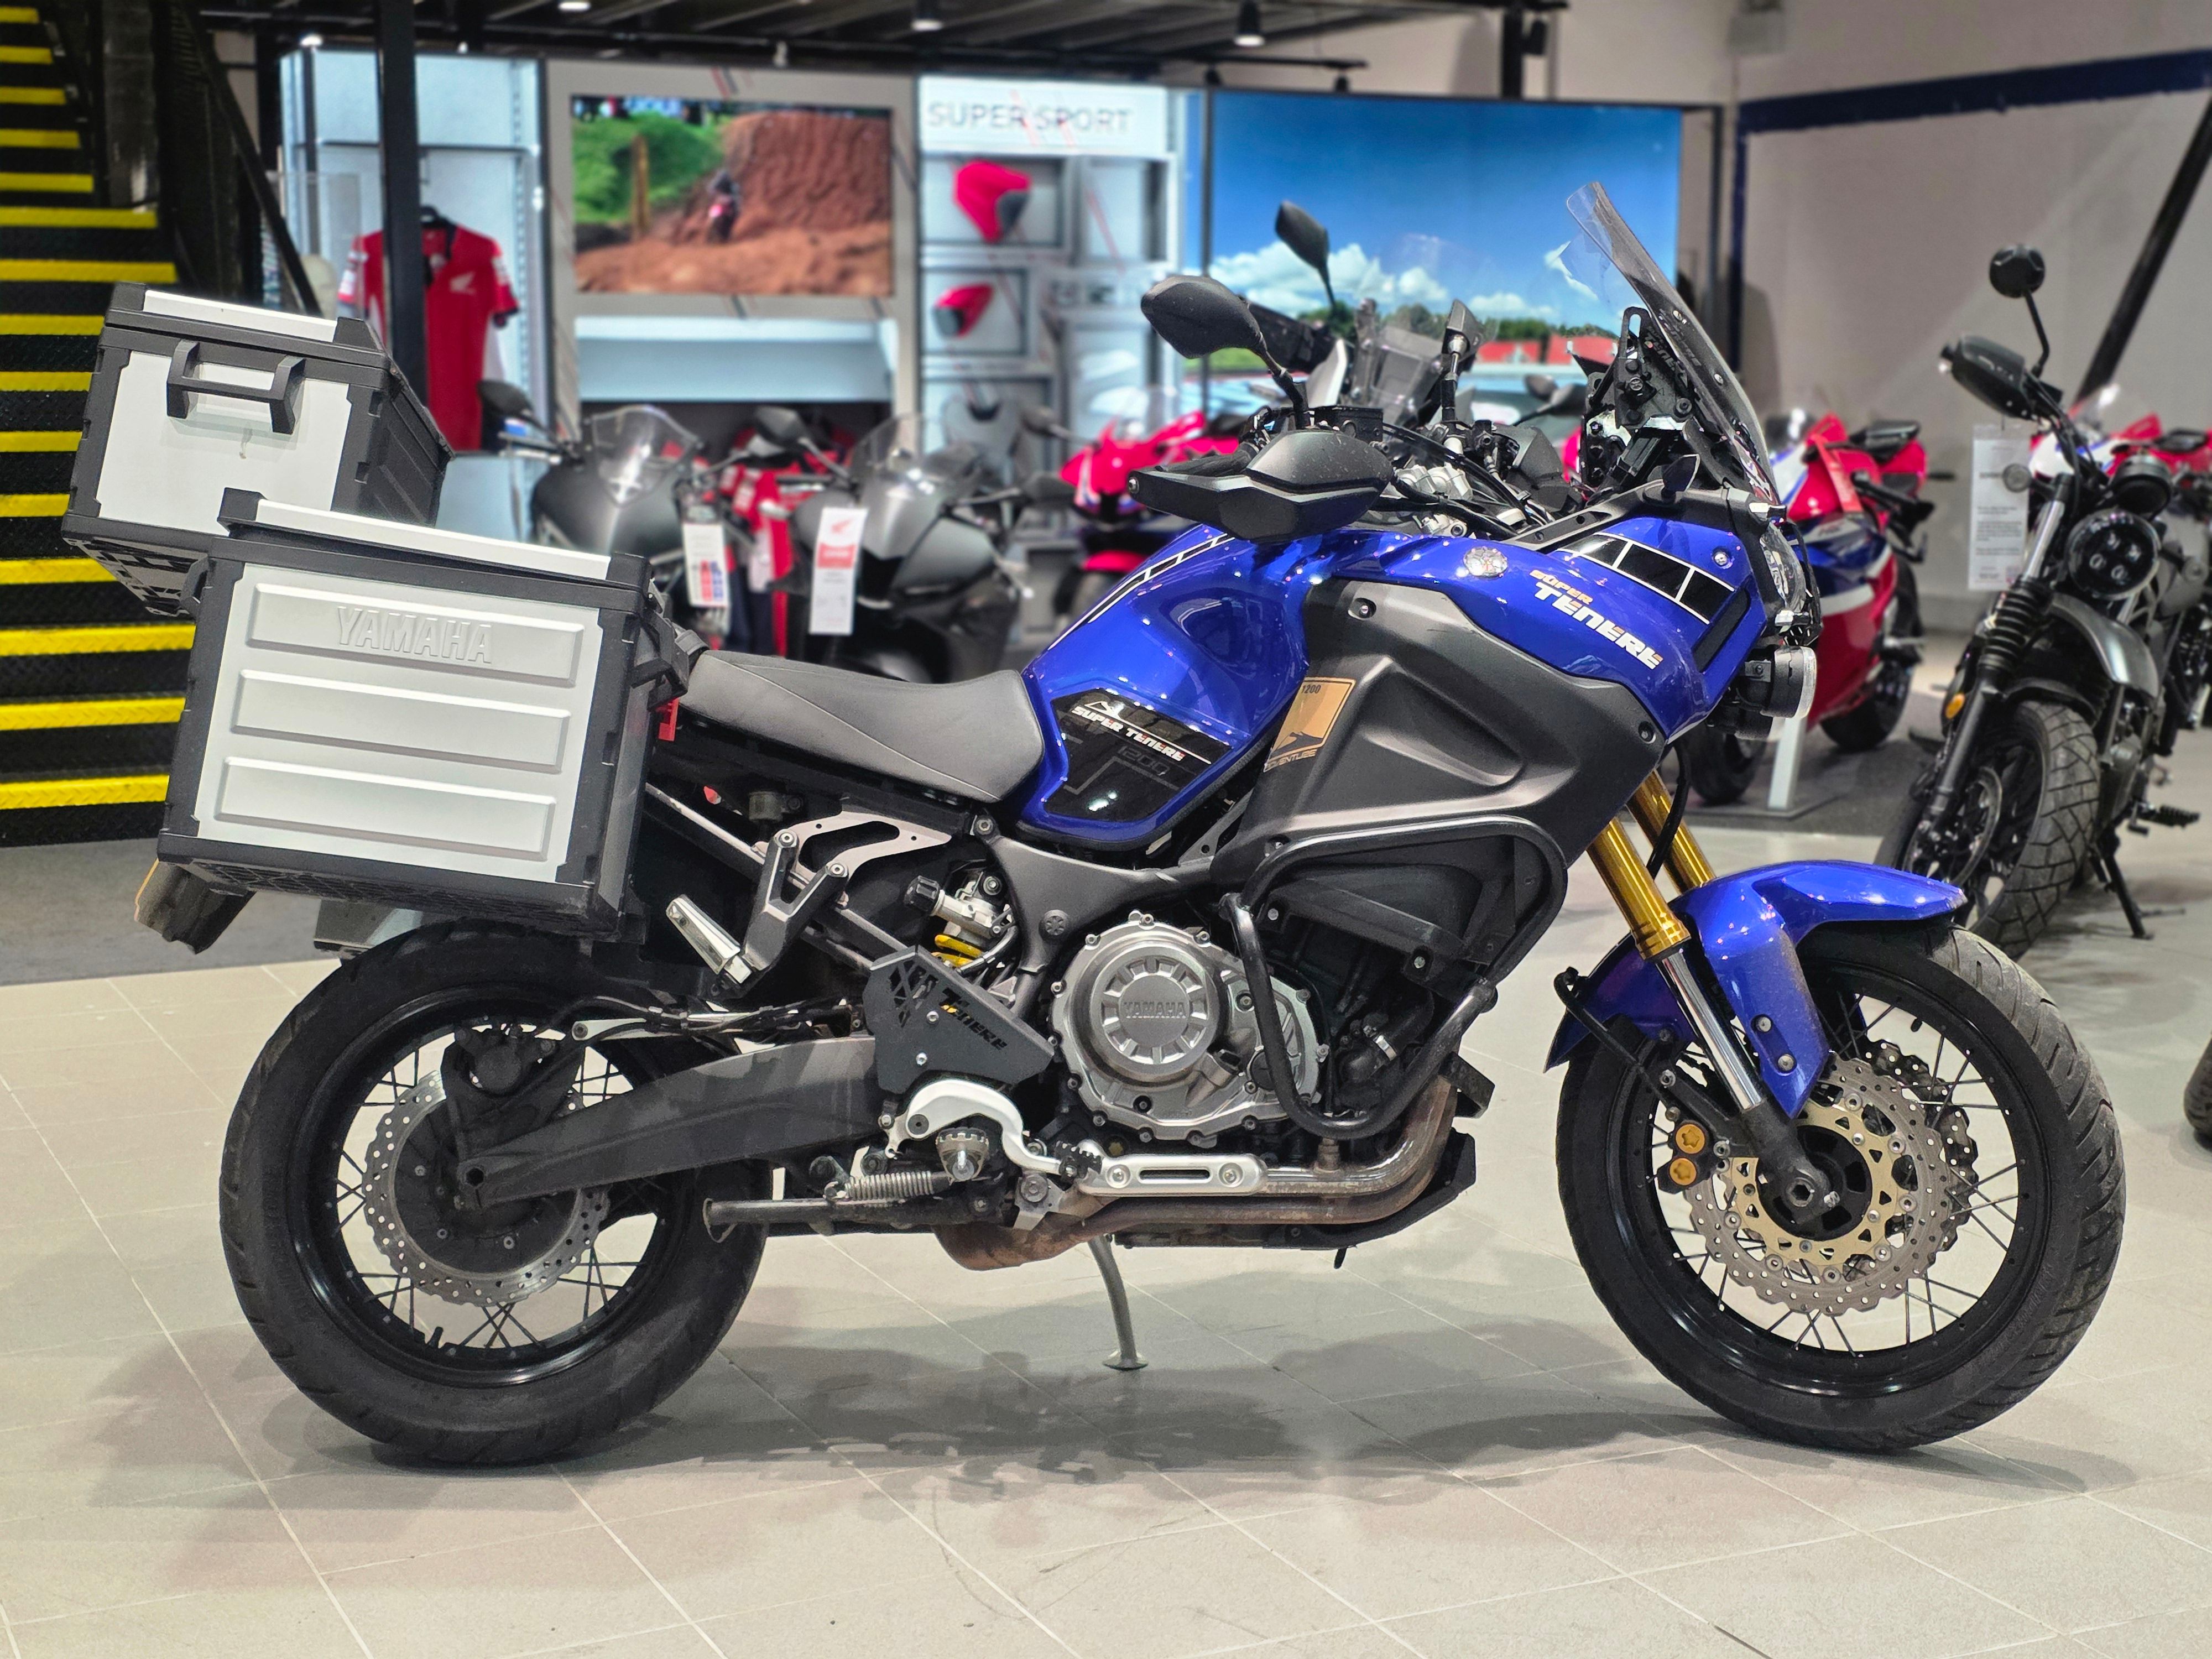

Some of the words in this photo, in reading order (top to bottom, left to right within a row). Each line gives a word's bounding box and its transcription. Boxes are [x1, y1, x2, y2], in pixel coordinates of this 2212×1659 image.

[927, 101, 1027, 128] SUPER
[1033, 105, 1129, 132] SPORT
[1529, 570, 1593, 605] SUPER
[337, 606, 492, 664] YAMAHA
[1534, 581, 1664, 670] TENERE
[1301, 685, 1322, 694] 1200
[1071, 706, 1124, 733] SUPER
[1125, 727, 1186, 762] TENERE
[1117, 745, 1170, 776] 1200
[1123, 1001, 1187, 1019] YAMAHA
